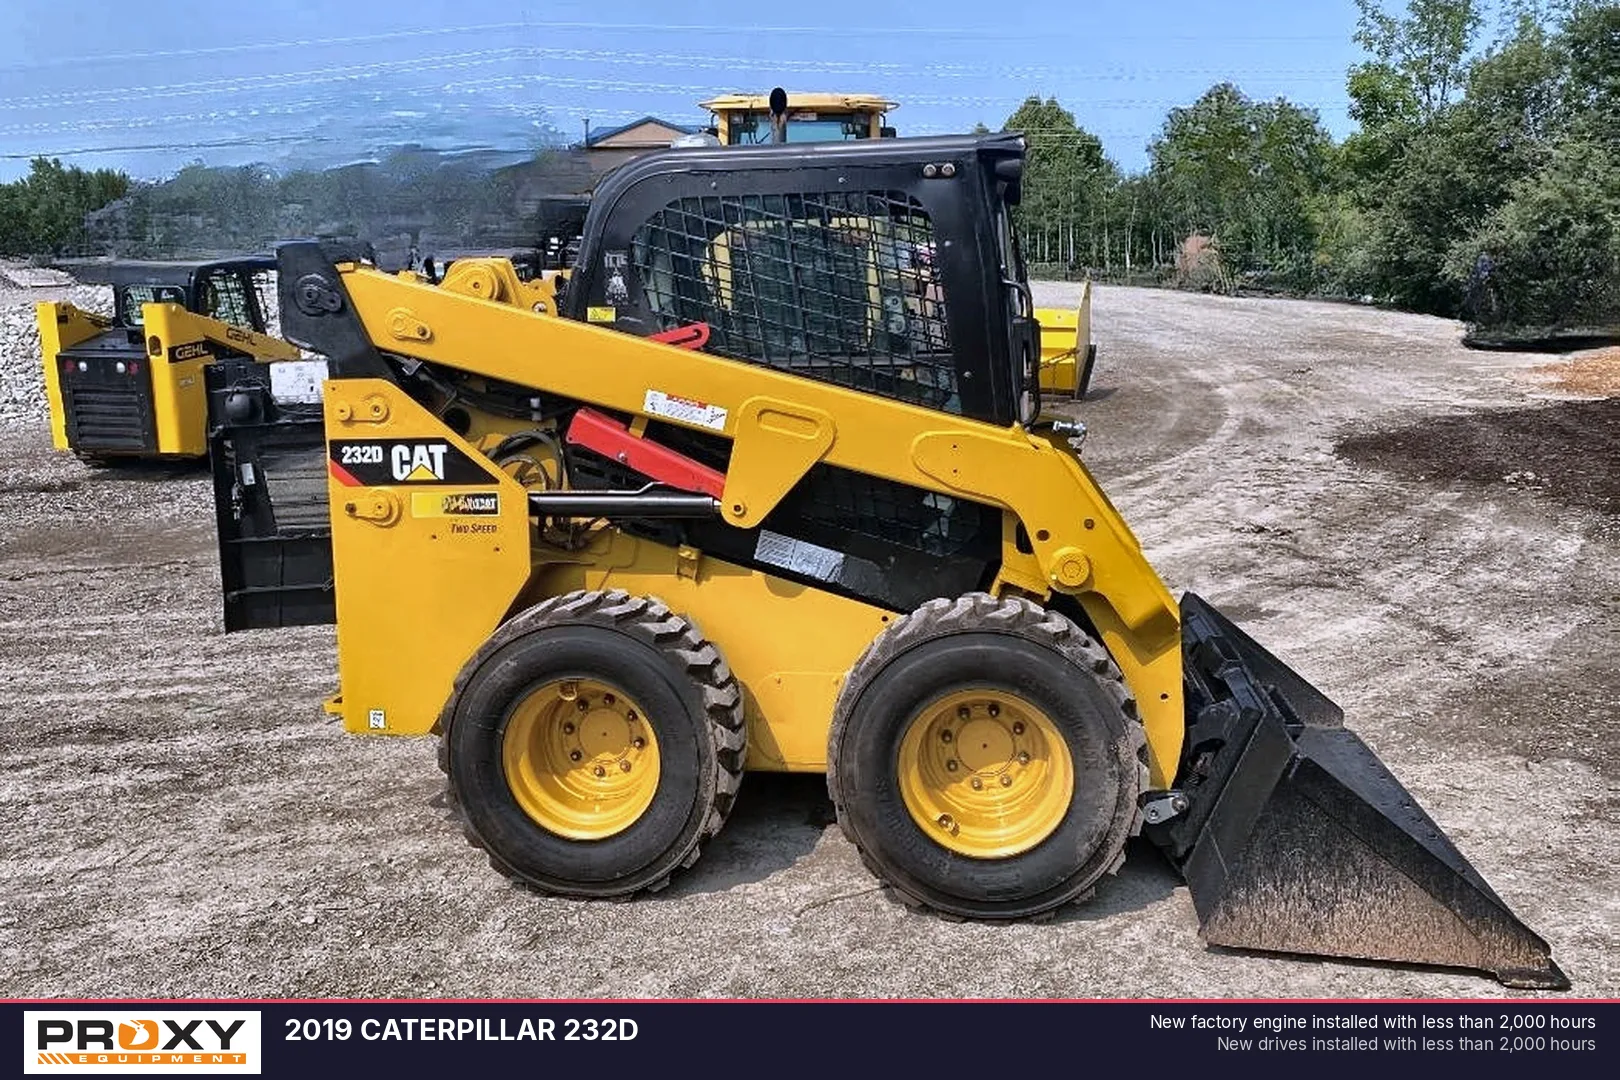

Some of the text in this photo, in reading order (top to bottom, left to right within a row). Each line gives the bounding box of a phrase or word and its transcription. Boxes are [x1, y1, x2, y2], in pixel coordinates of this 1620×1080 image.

[226, 328, 257, 346] GEHL
[175, 343, 208, 360] GEHL
[341, 446, 383, 463] 232D
[391, 444, 447, 481] CAT
